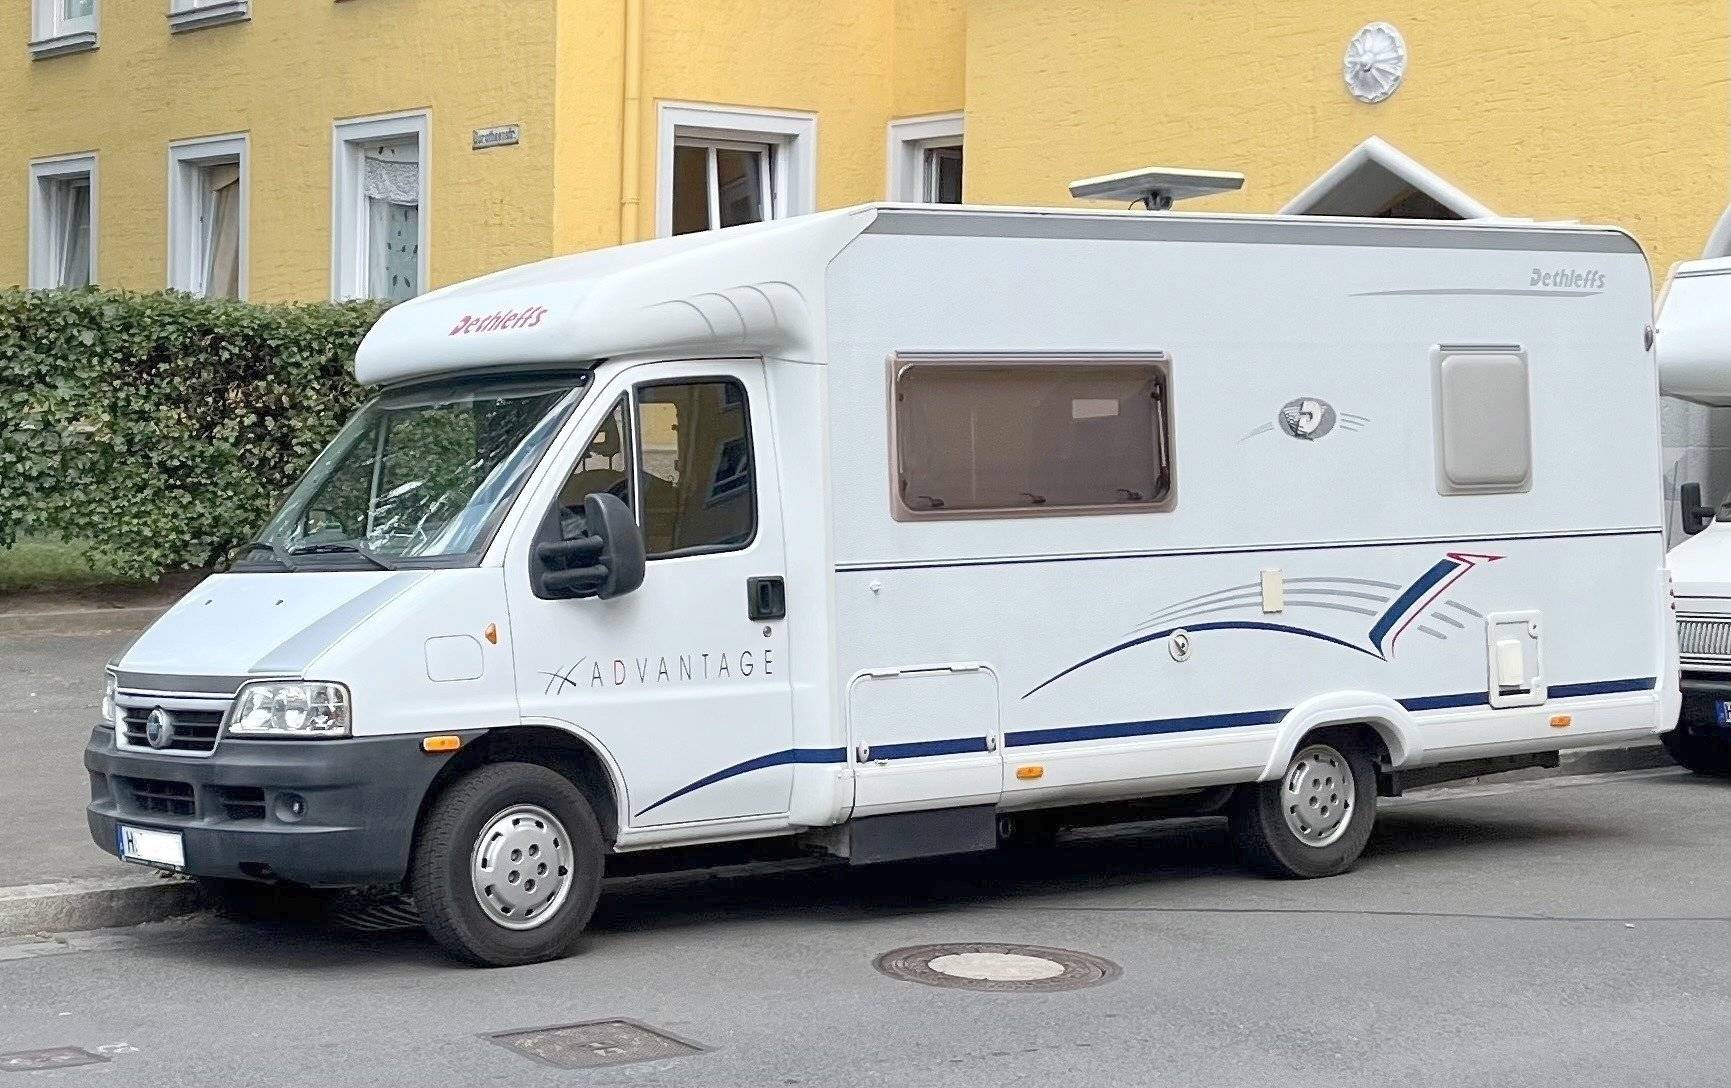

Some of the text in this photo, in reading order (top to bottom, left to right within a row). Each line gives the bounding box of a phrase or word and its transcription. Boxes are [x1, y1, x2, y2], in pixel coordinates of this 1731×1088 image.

[1529, 267, 1606, 289] Dethleffs
[448, 305, 549, 336] Dethleffs
[591, 649, 773, 687] ADVANTAGE
